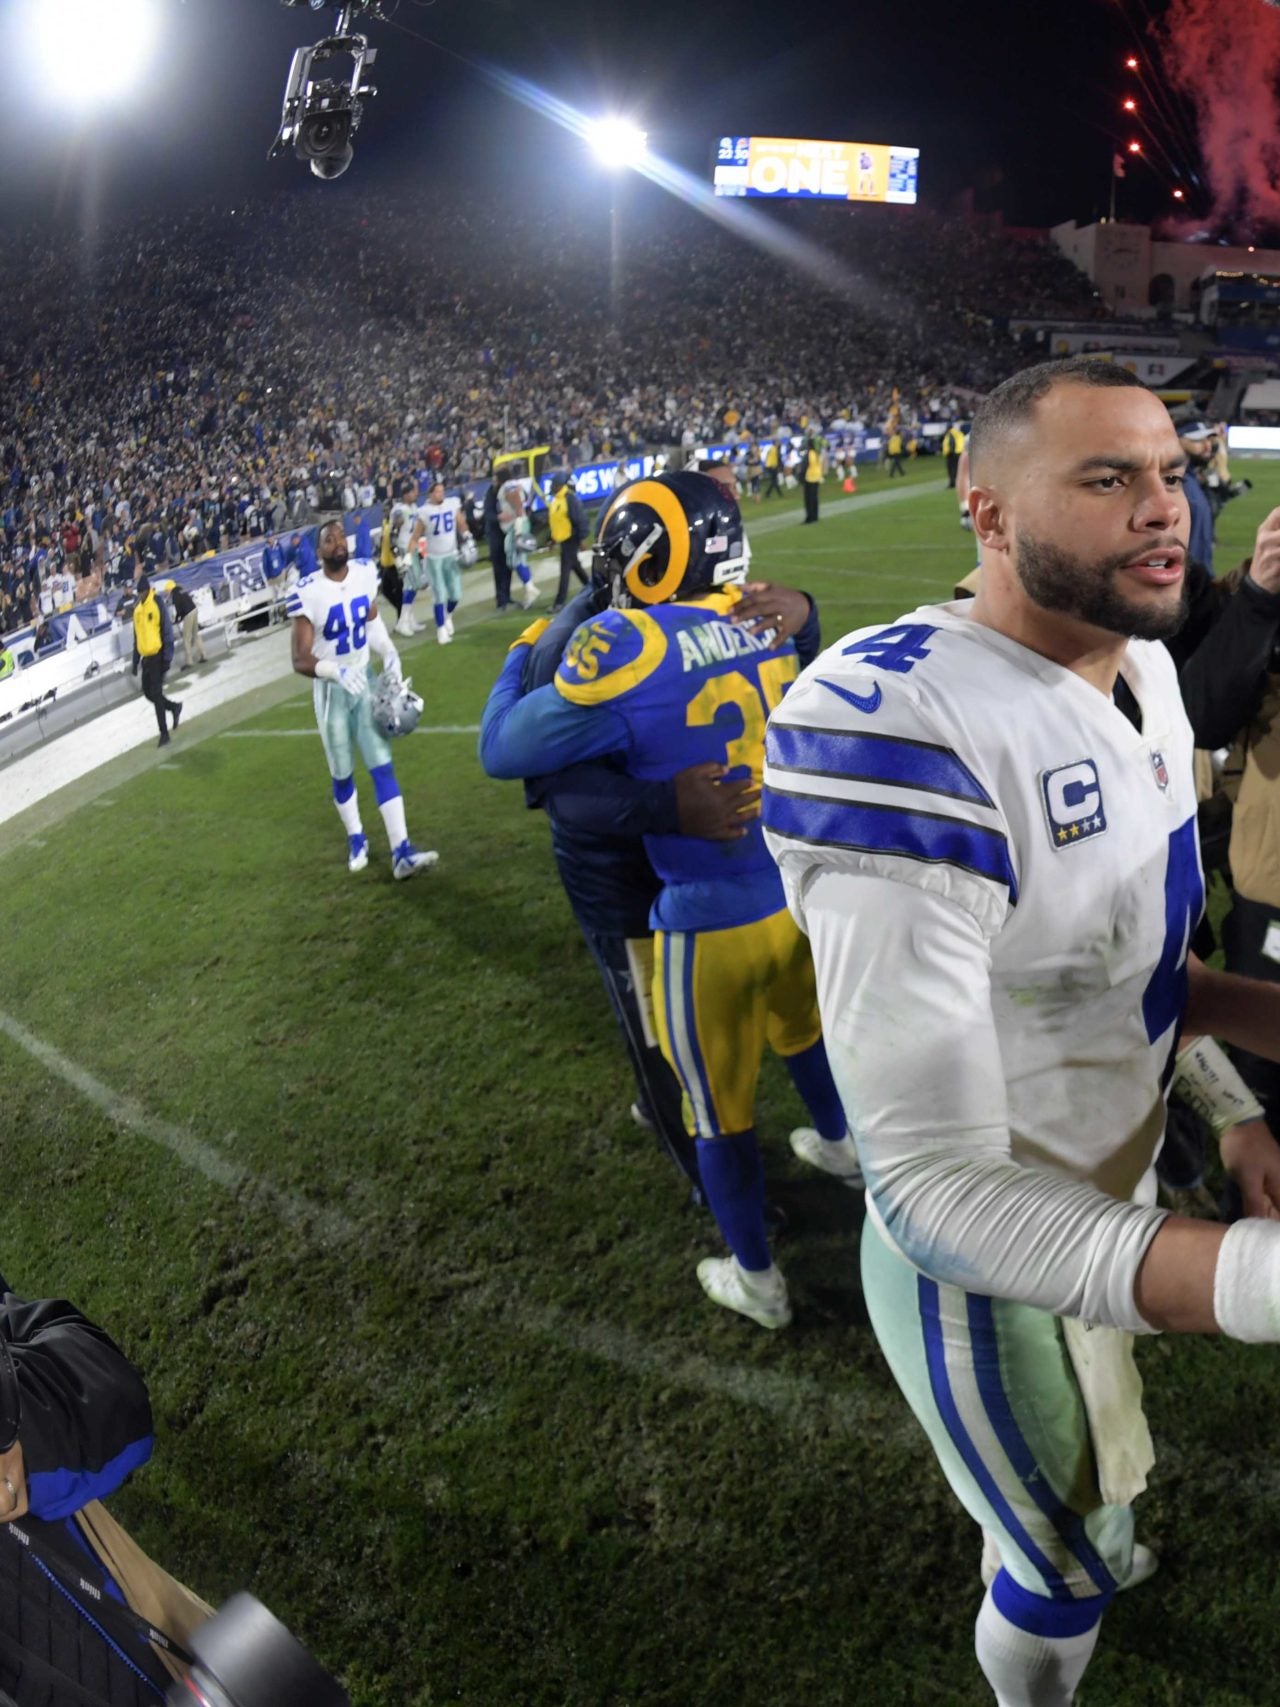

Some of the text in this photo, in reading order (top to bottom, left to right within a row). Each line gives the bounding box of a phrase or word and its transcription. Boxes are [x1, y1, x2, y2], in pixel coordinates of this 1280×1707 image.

[751, 156, 848, 196] ONE
[429, 511, 453, 535] 76
[323, 594, 369, 656] 48
[676, 618, 778, 673] ANDER
[842, 624, 942, 674] 4
[565, 627, 612, 680] 35
[1045, 762, 1100, 826] C
